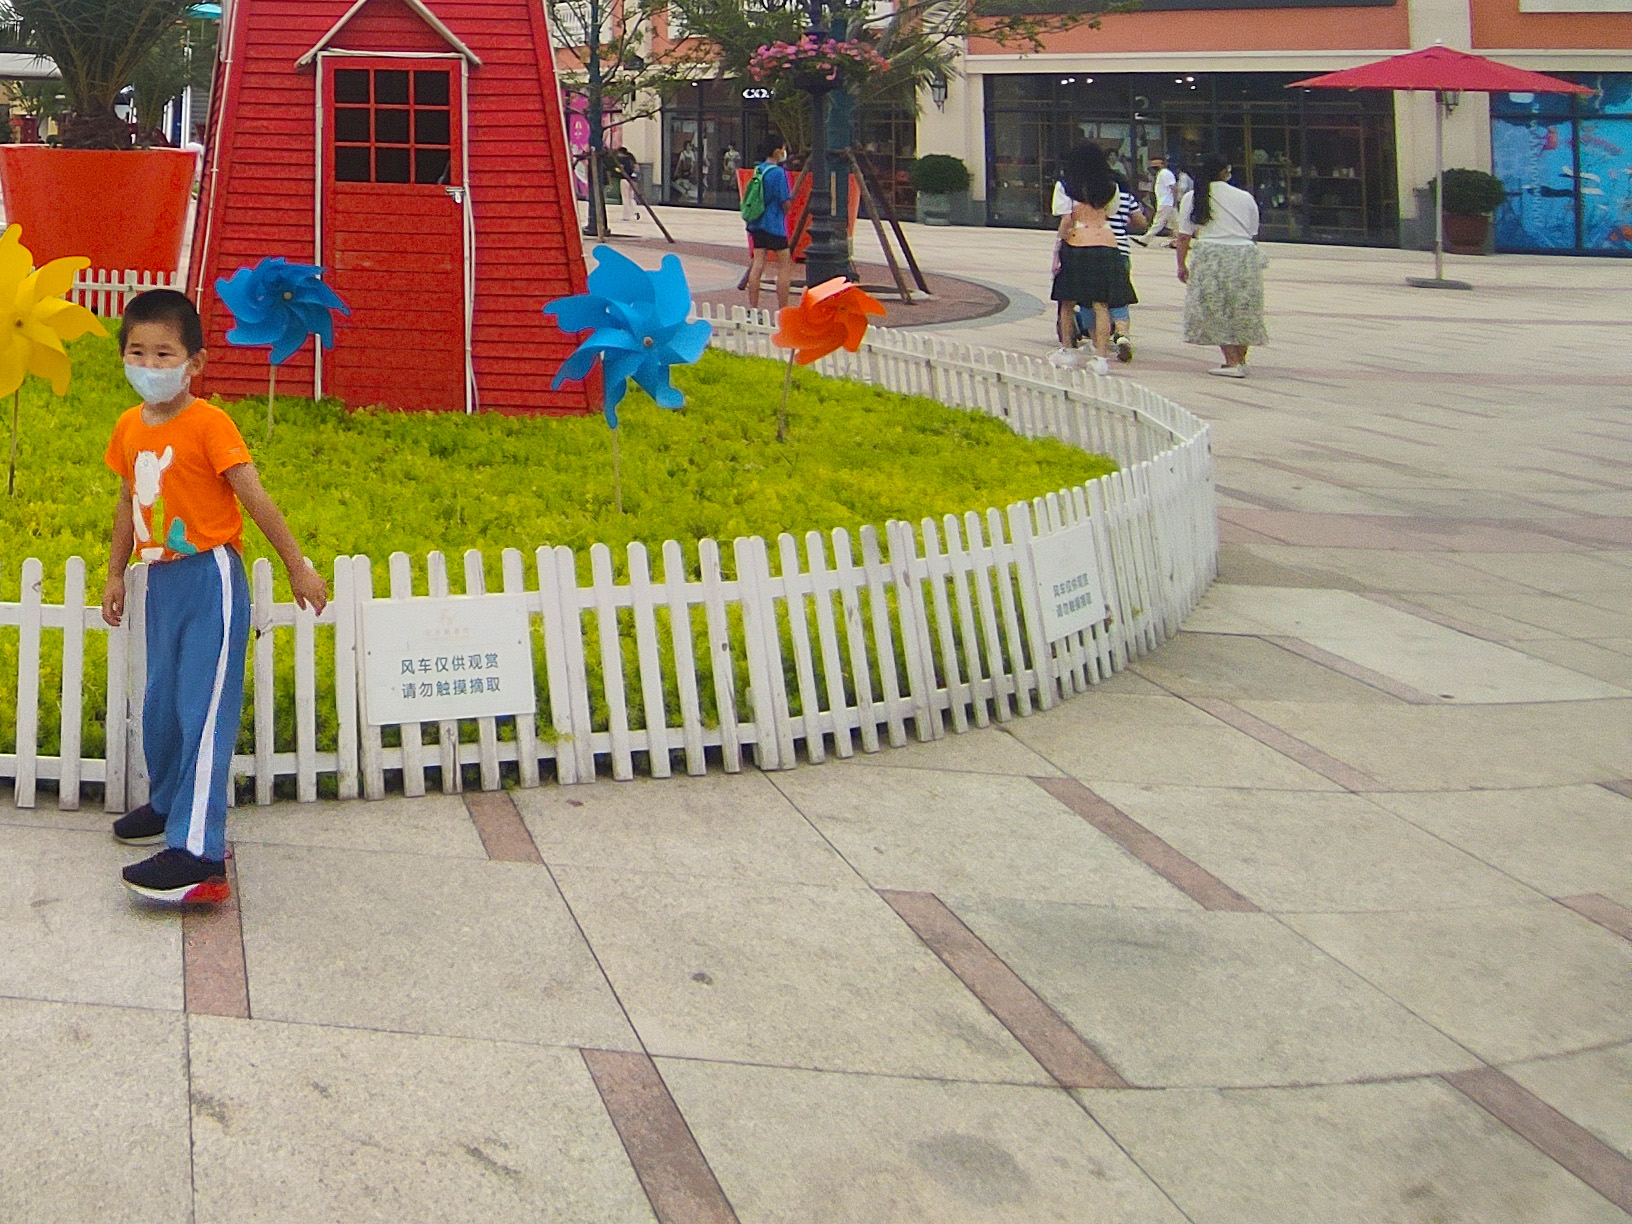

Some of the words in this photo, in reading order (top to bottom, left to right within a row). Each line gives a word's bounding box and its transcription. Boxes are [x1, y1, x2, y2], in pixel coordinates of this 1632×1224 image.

[401, 652, 499, 675] 风车仅供观赏
[402, 677, 501, 699] 请勿触摸摘取
